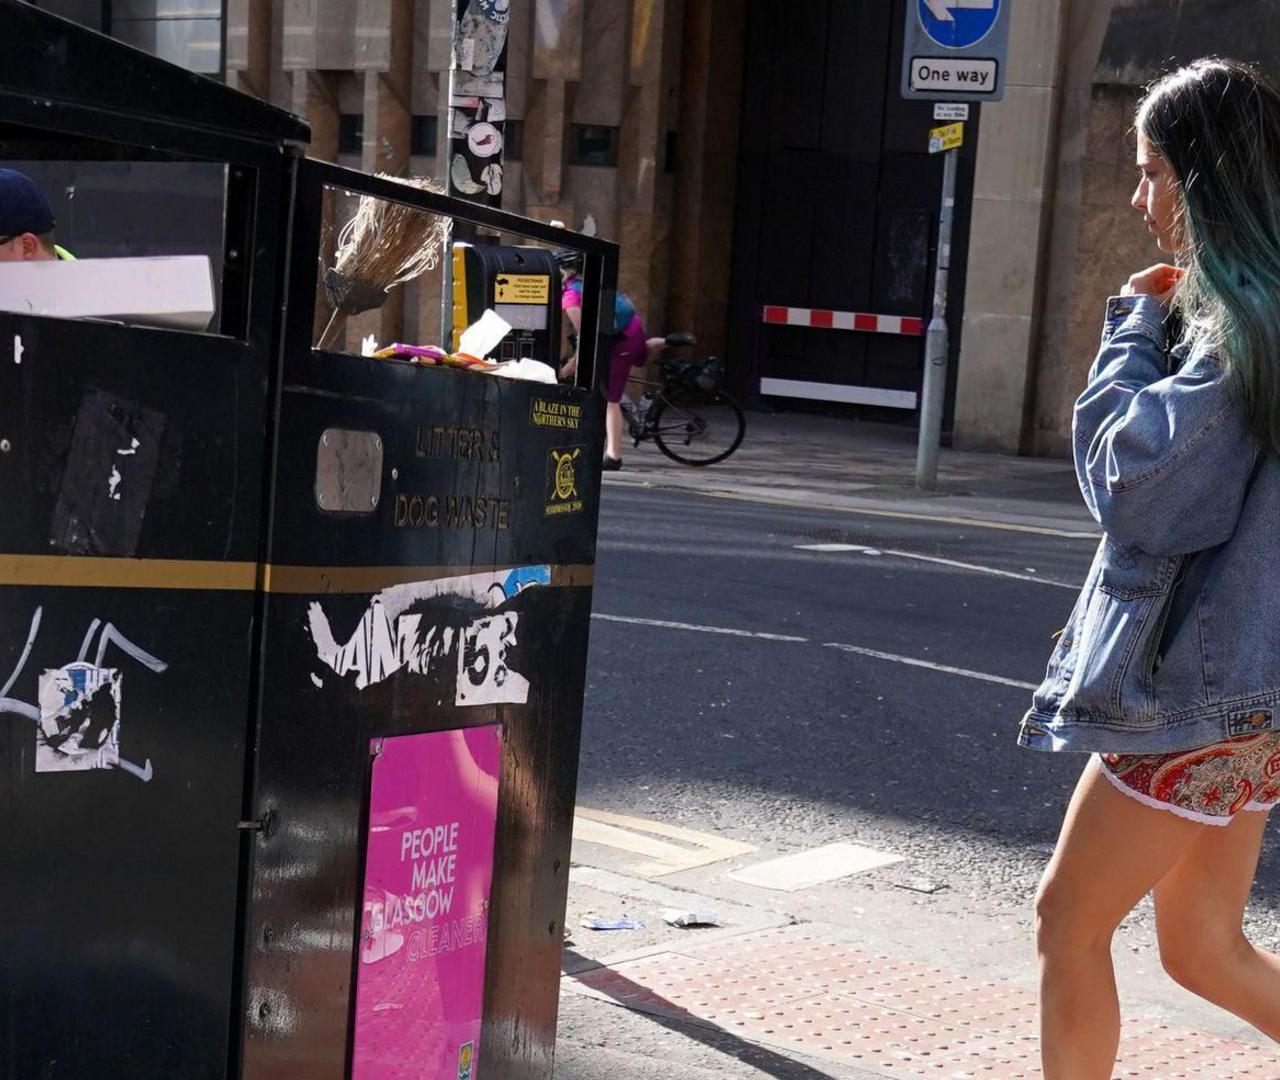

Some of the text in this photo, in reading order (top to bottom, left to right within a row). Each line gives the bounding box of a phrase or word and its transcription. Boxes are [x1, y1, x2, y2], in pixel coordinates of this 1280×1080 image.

[918, 66, 989, 86] One way
[567, 417, 580, 429] SKY
[415, 425, 486, 462] LITTER
[394, 493, 511, 531] DOG WASTE
[401, 822, 460, 862] PEOPLE
[411, 854, 457, 892] MAKE
[370, 886, 455, 933] GLASGOW
[406, 914, 485, 962] CLEANER
